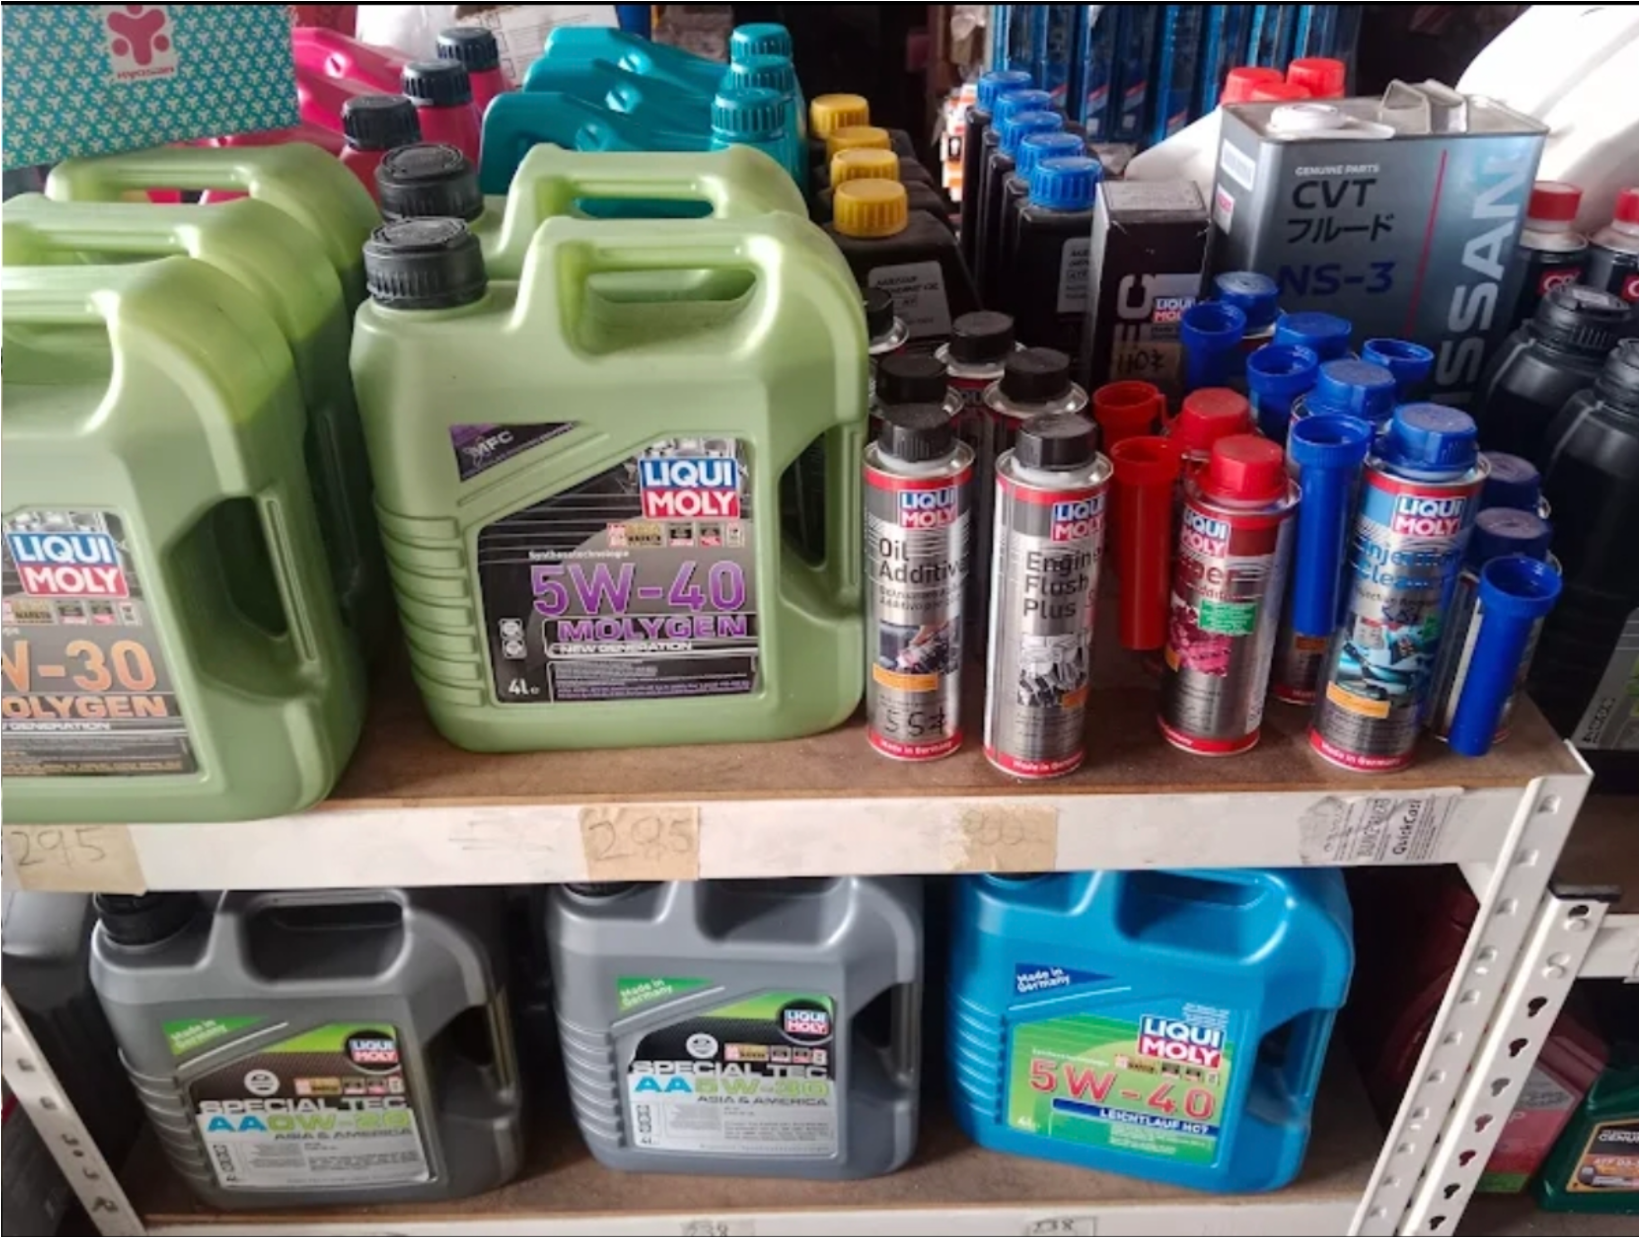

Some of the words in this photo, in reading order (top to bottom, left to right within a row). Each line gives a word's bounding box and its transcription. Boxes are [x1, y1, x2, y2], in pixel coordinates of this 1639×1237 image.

[1295, 166, 1342, 176] GENUINE
[1345, 163, 1380, 174] PARTS
[1292, 178, 1377, 210] CVT
[1287, 213, 1395, 244] フルード
[1278, 261, 1397, 297] NS-3
[1430, 150, 1532, 403] ISSAN
[644, 462, 733, 488] LIQUI
[648, 491, 736, 516] MOLY
[901, 488, 956, 510] LIQUI
[1399, 498, 1463, 518] LIQUI
[902, 506, 956, 528] MOLY
[1394, 516, 1459, 536] MOLY
[11, 535, 113, 564] LIQUI
[879, 537, 910, 562] Oil
[23, 566, 122, 593] MOLY
[530, 560, 746, 616] 5W-40
[1025, 573, 1089, 597] Flush
[1023, 598, 1076, 619] Plus
[557, 615, 748, 643] MOLYGEN
[3, 696, 168, 718] OLYGEN
[10, 826, 107, 869] 295
[1017, 970, 1049, 984] Made
[1017, 974, 1071, 993] Germany
[786, 1009, 828, 1022] LIQUI
[788, 1021, 829, 1035] MOLY
[1144, 1017, 1220, 1046] LIQUI
[1141, 1037, 1220, 1068] MOLY
[632, 1061, 762, 1077] SPECIAL
[767, 1063, 827, 1079] TEC
[1029, 1057, 1216, 1120] 5W-40
[200, 1098, 338, 1115] SPECIAL
[341, 1096, 406, 1111] TEC
[1099, 1108, 1179, 1131] LEICHTLAUF
